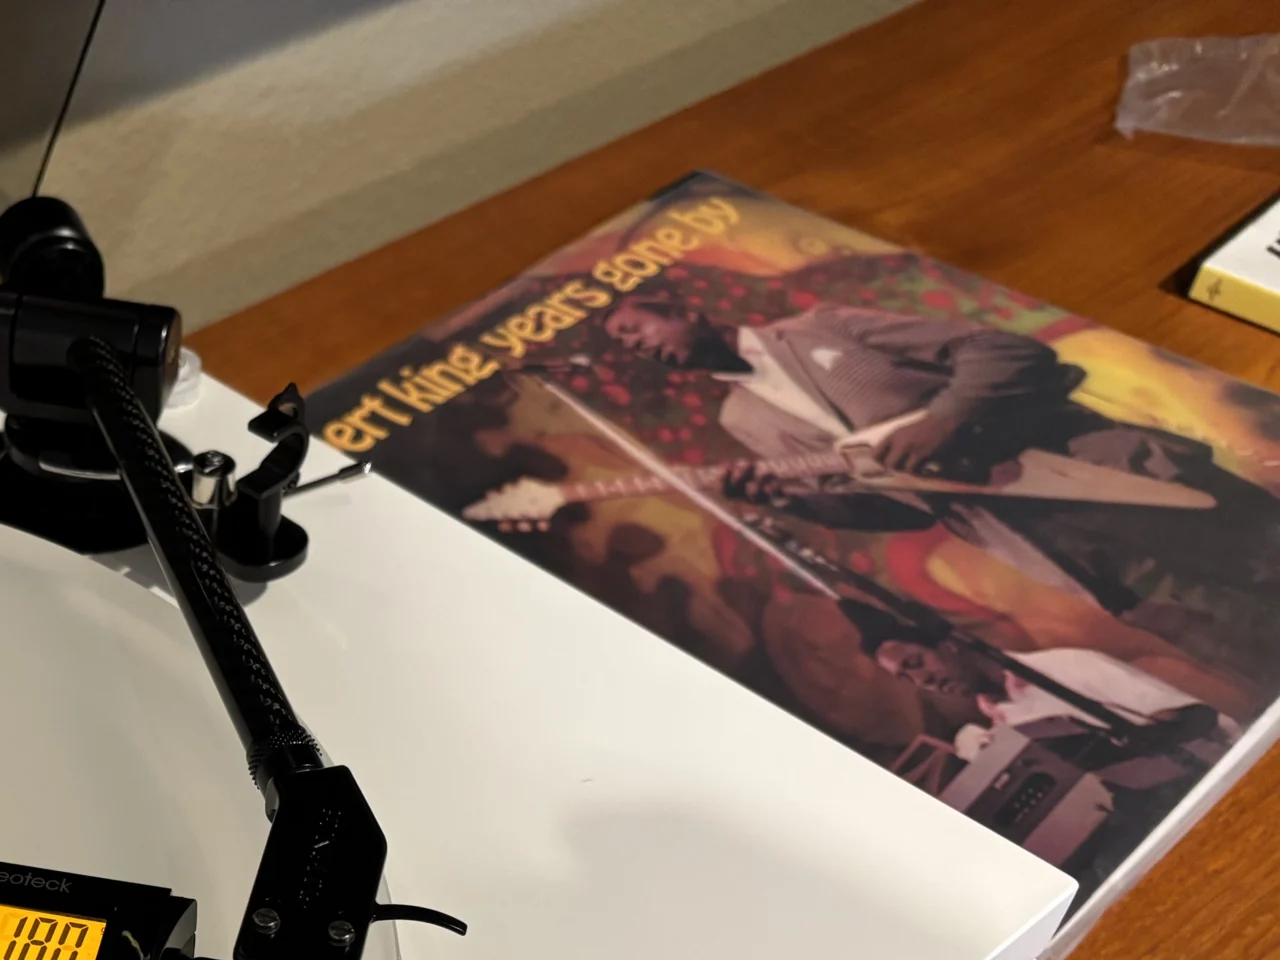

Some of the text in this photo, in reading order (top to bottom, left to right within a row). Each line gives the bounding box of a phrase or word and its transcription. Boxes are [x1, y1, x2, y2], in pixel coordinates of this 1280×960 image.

[376, 341, 499, 413] king
[480, 278, 612, 358] years
[592, 227, 700, 291] gone
[670, 196, 740, 235] by
